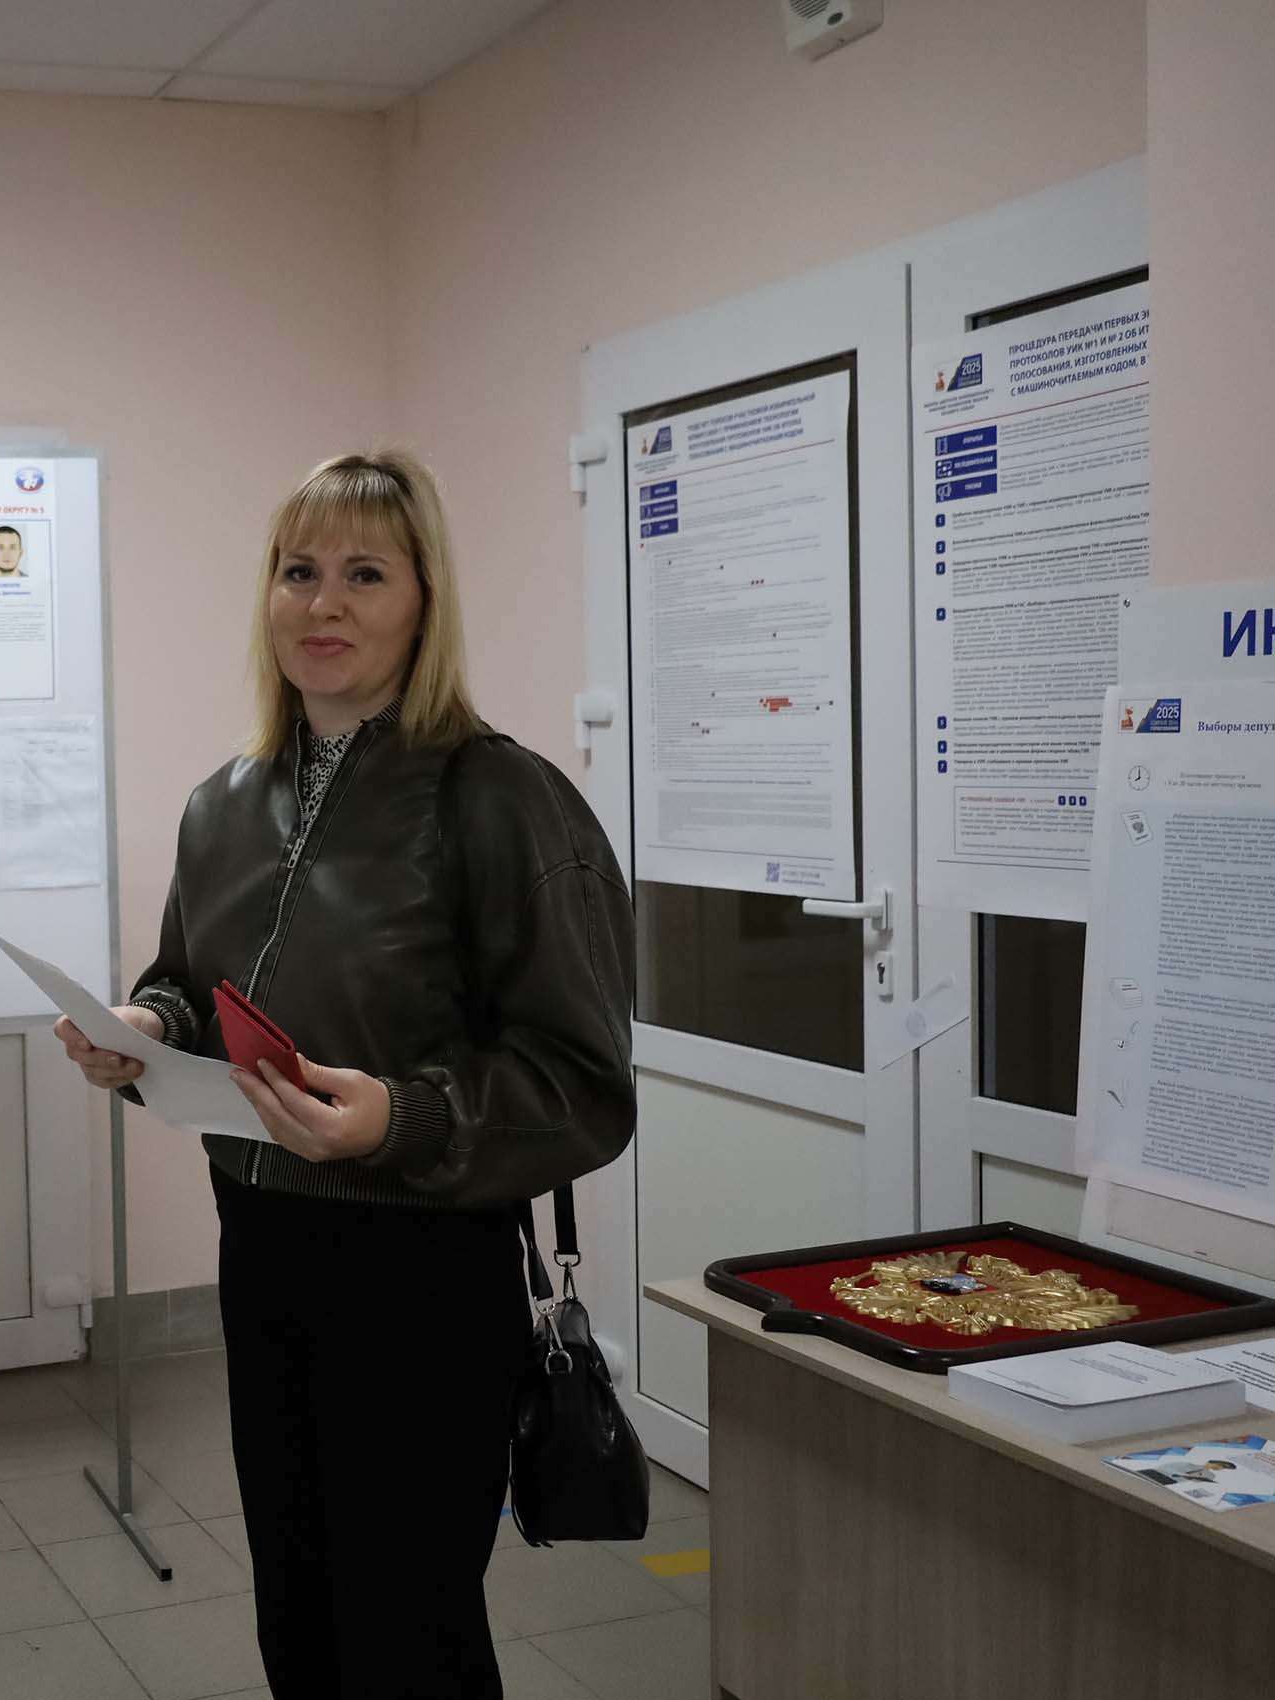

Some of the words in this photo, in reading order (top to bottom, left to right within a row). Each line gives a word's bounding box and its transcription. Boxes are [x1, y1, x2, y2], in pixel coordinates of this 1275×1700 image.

[1009, 335, 1056, 355] ПРОЦЕДУРА
[1059, 323, 1103, 342] ПЕРЕДАЧИ
[1105, 312, 1140, 328] ПЕРВЫХ
[1010, 348, 1065, 369] ПРОТОКОЛОВ
[1067, 342, 1083, 356] УИК
[1100, 336, 1107, 346] И
[1125, 327, 1137, 339] ОБ
[1074, 340, 1147, 367] ИЗГОТОВЛЕННЫХ
[962, 363, 981, 376] 2025
[1017, 368, 1104, 395] МАШИНОЧИТАЕМЫМ
[1156, 706, 1180, 719] 2025
[1197, 720, 1241, 734] Выборы
